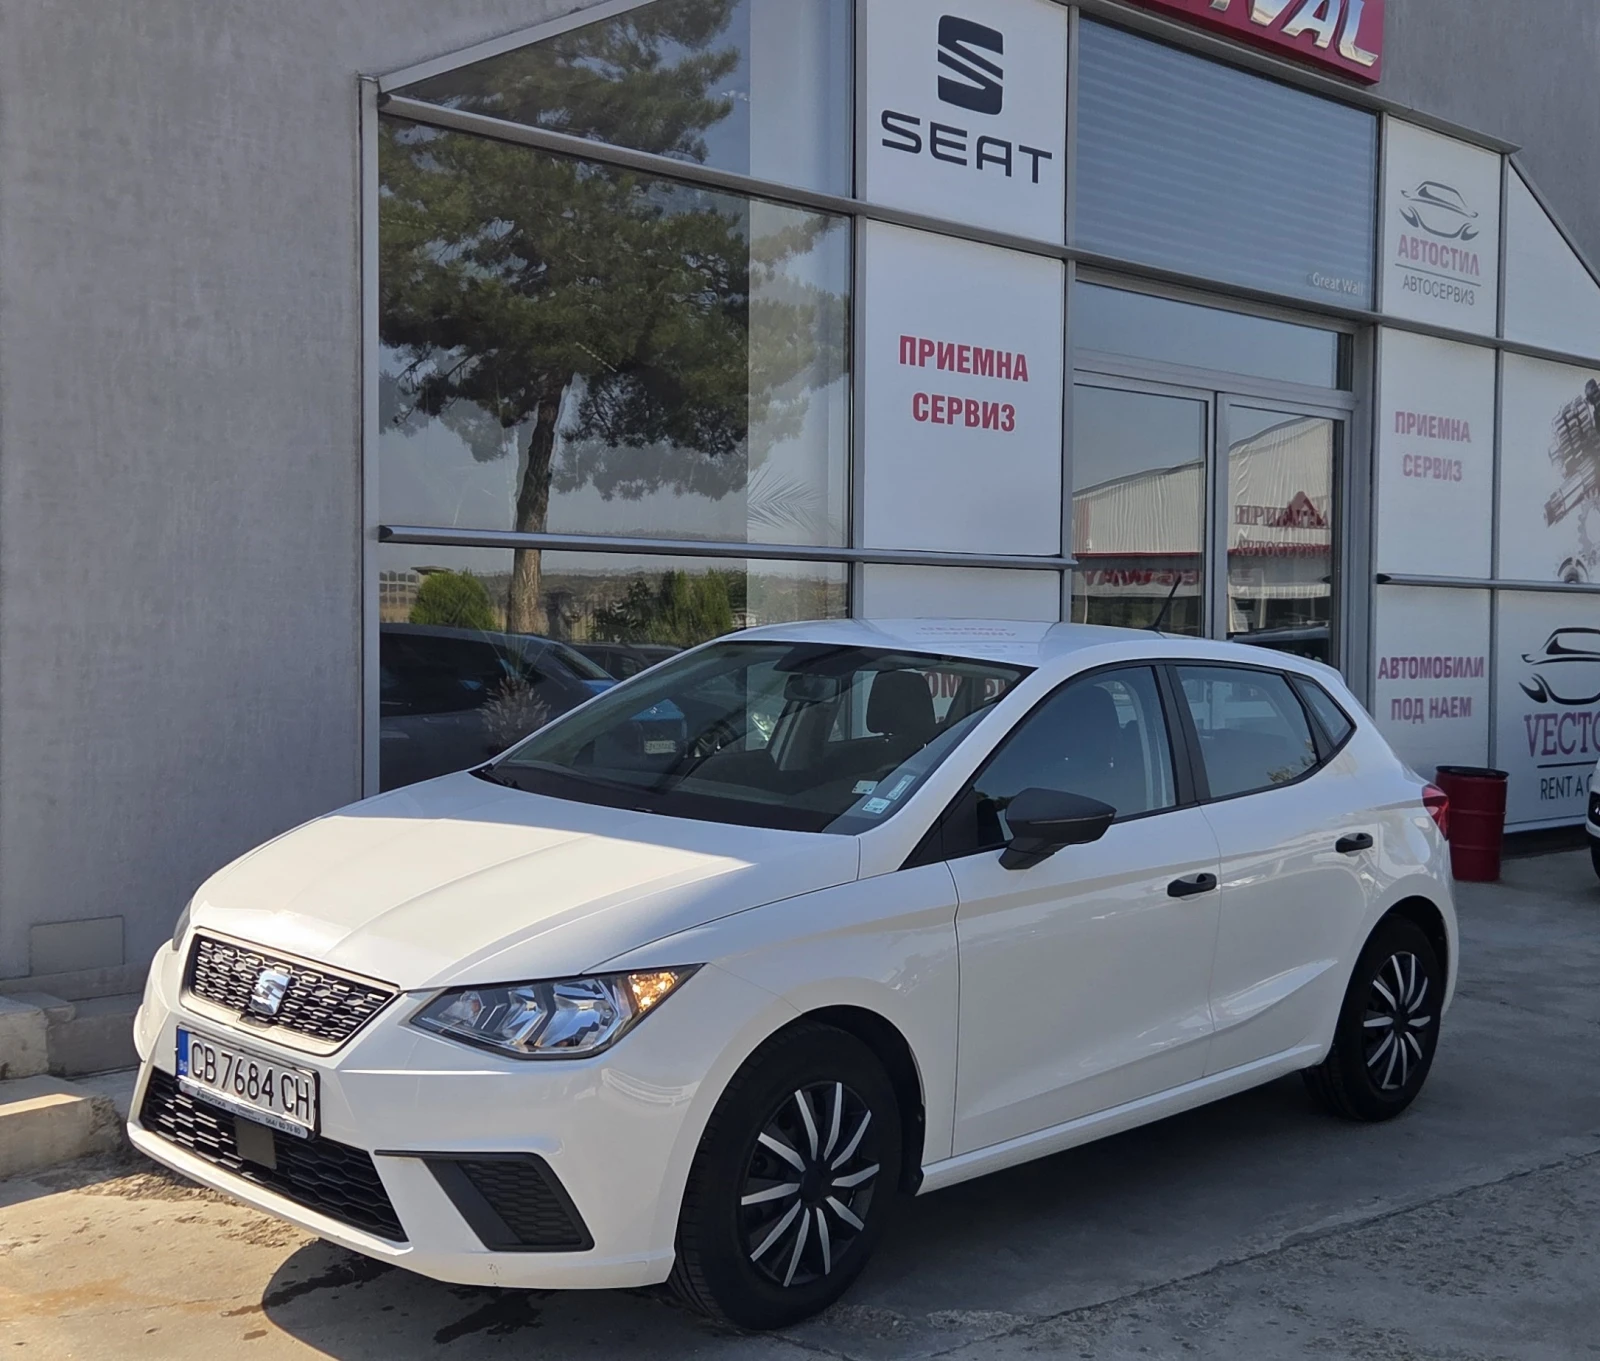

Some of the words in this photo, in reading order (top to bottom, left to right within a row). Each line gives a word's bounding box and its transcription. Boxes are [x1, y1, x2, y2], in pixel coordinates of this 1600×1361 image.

[881, 109, 1053, 184] SEAT
[1397, 234, 1481, 277] АВТОСТИЛ
[1311, 271, 1340, 291] Great
[1341, 278, 1364, 297] Wall
[1402, 274, 1476, 306] АВТОСЕРВИЗ
[899, 334, 1029, 383] ПРИЕМНА
[912, 391, 1016, 433] СЕРВИЗ
[1394, 411, 1472, 443] ПРИЕМНА
[1402, 454, 1463, 483] СЕРВИЗ
[1377, 656, 1485, 680] АВТОМОБИЛИ
[1390, 697, 1425, 725] ПОД
[1428, 696, 1473, 720] НАЕМ
[1540, 775, 1573, 800] RENT
[1574, 775, 1585, 797] A
[191, 1040, 217, 1084] CB
[221, 1051, 274, 1108] 7684
[280, 1072, 310, 1122] CH
